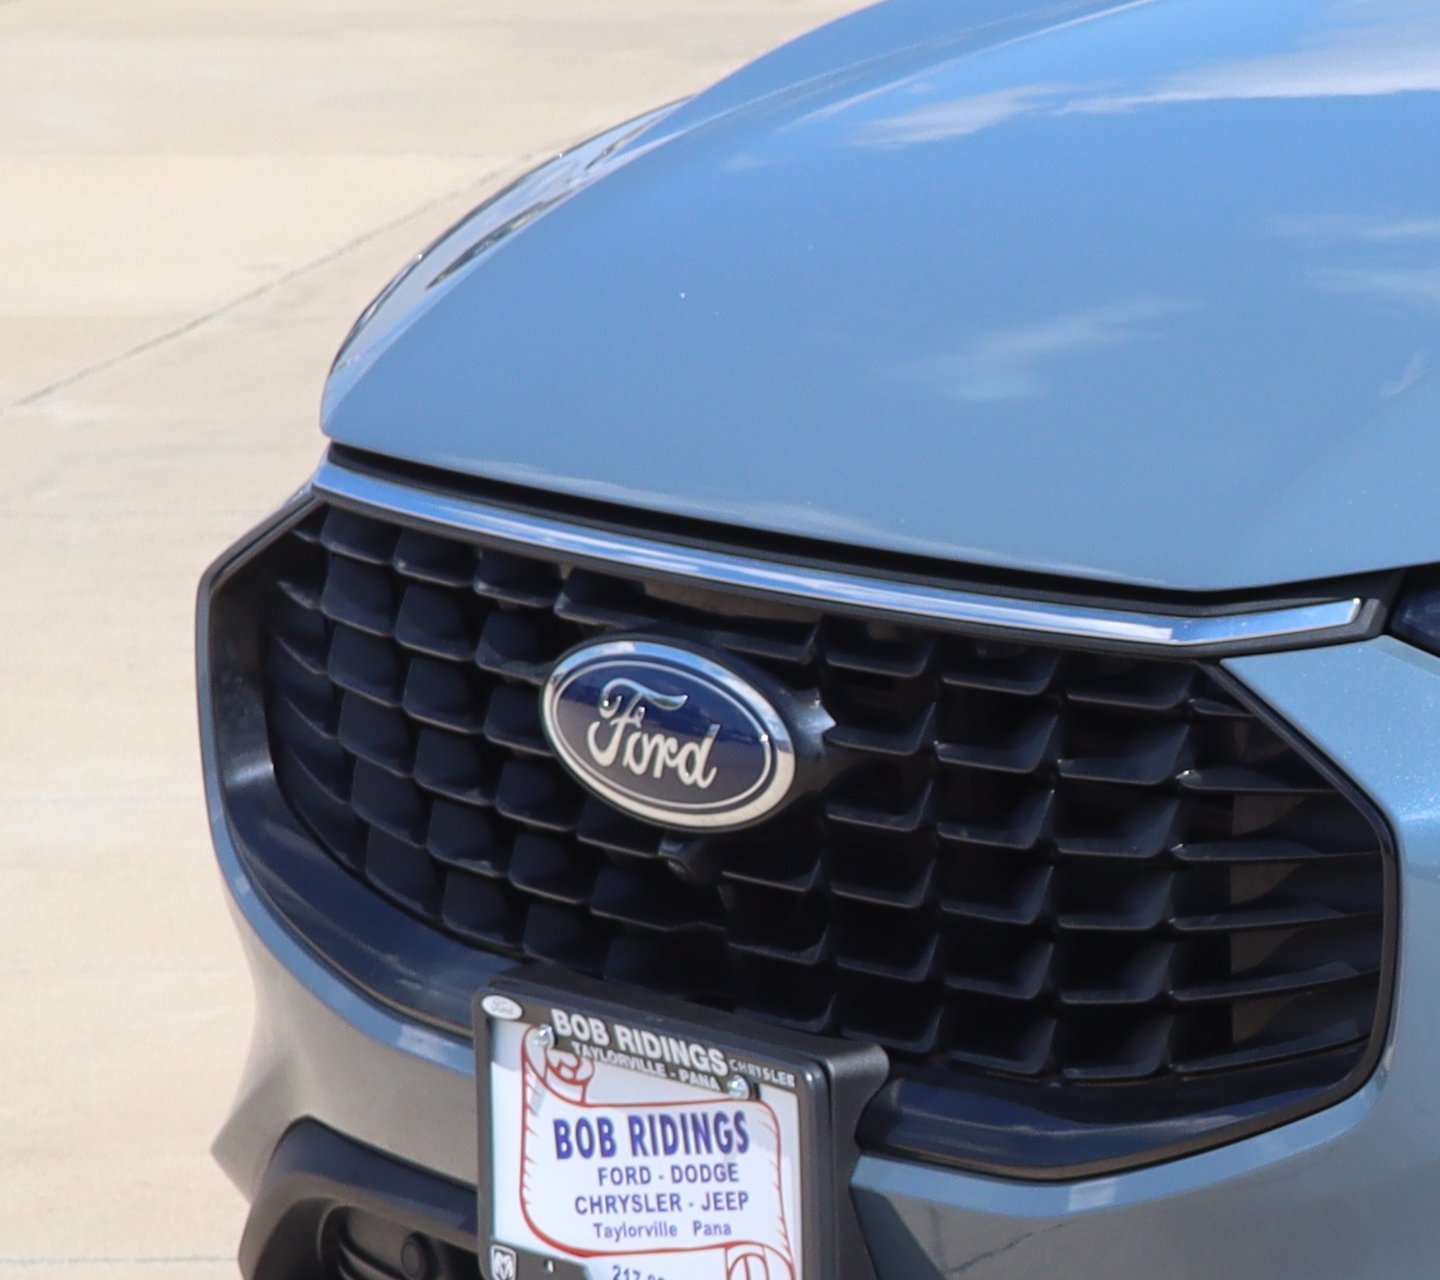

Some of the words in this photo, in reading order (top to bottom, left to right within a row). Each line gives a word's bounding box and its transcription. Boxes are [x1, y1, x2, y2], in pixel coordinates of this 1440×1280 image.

[588, 677, 720, 789] Ford
[551, 1008, 611, 1047] BOB
[613, 1023, 730, 1077] RIDINGS
[728, 1058, 797, 1089] CHRYSLER
[570, 1039, 668, 1079] TAYLORVILLE
[677, 1068, 722, 1092] PANA
[553, 1116, 617, 1160] BOB
[627, 1110, 750, 1157] RIDINGS
[597, 1165, 652, 1187] FORD
[670, 1162, 740, 1185] DODGE
[574, 1193, 682, 1215] CHRYSLER
[701, 1191, 750, 1212] JEEP
[593, 1221, 678, 1243] Taylorville
[692, 1220, 732, 1237] Pana
